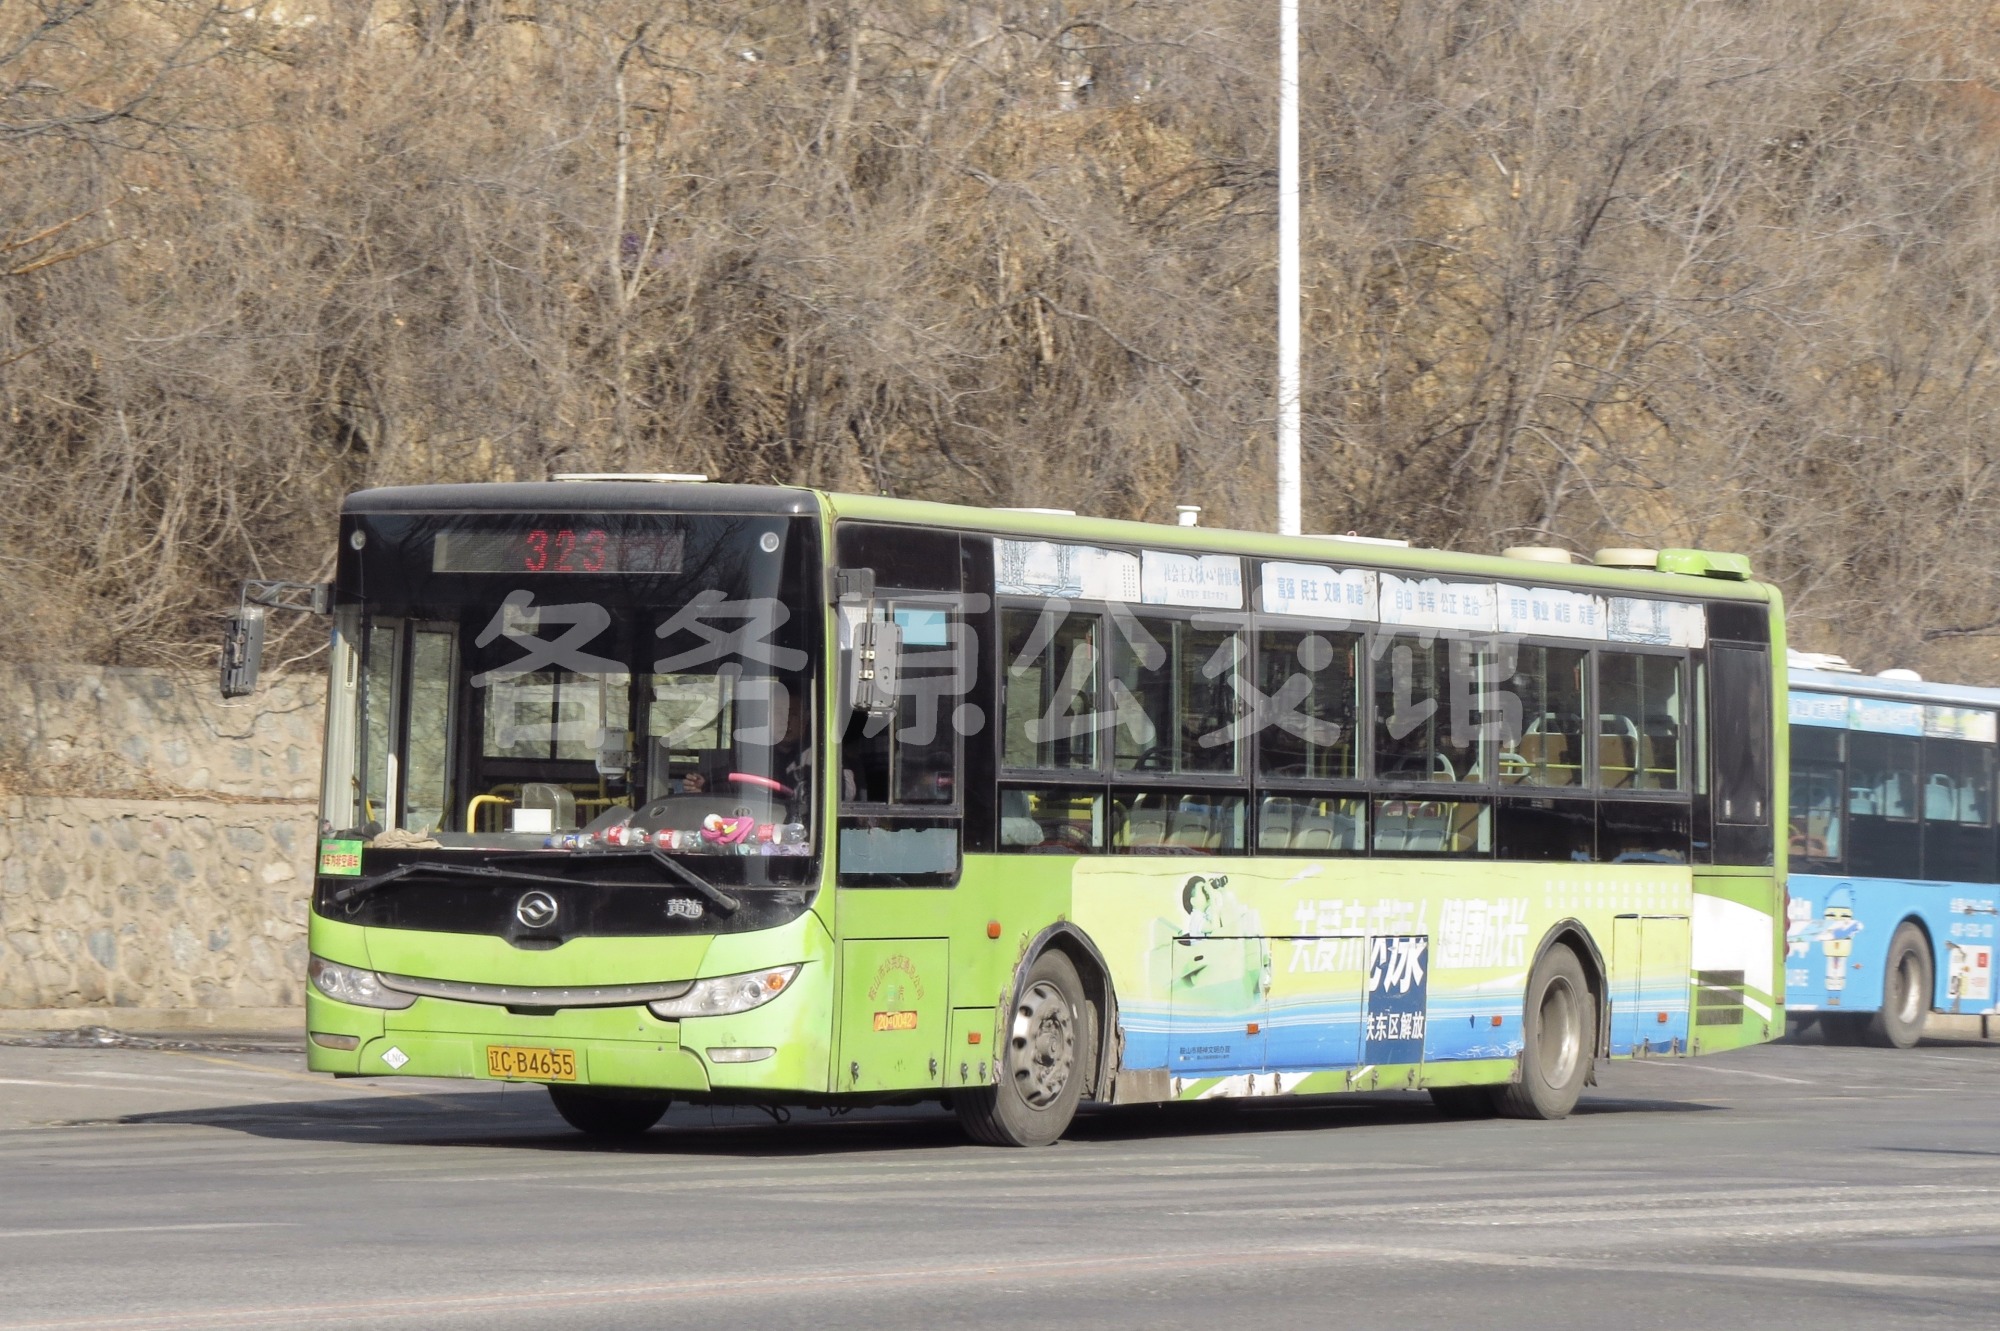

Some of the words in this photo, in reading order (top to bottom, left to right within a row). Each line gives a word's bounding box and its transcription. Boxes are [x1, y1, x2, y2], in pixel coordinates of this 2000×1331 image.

[525, 530, 607, 571] 323
[1301, 579, 1318, 601] 民主
[1323, 580, 1341, 603] 文明
[1396, 588, 1412, 610] 自由
[1418, 591, 1435, 612] 平等
[1441, 593, 1457, 614] 公正
[667, 899, 703, 919] 黄海
[1435, 897, 1529, 968] 健康成长
[386, 1052, 405, 1064] LNG
